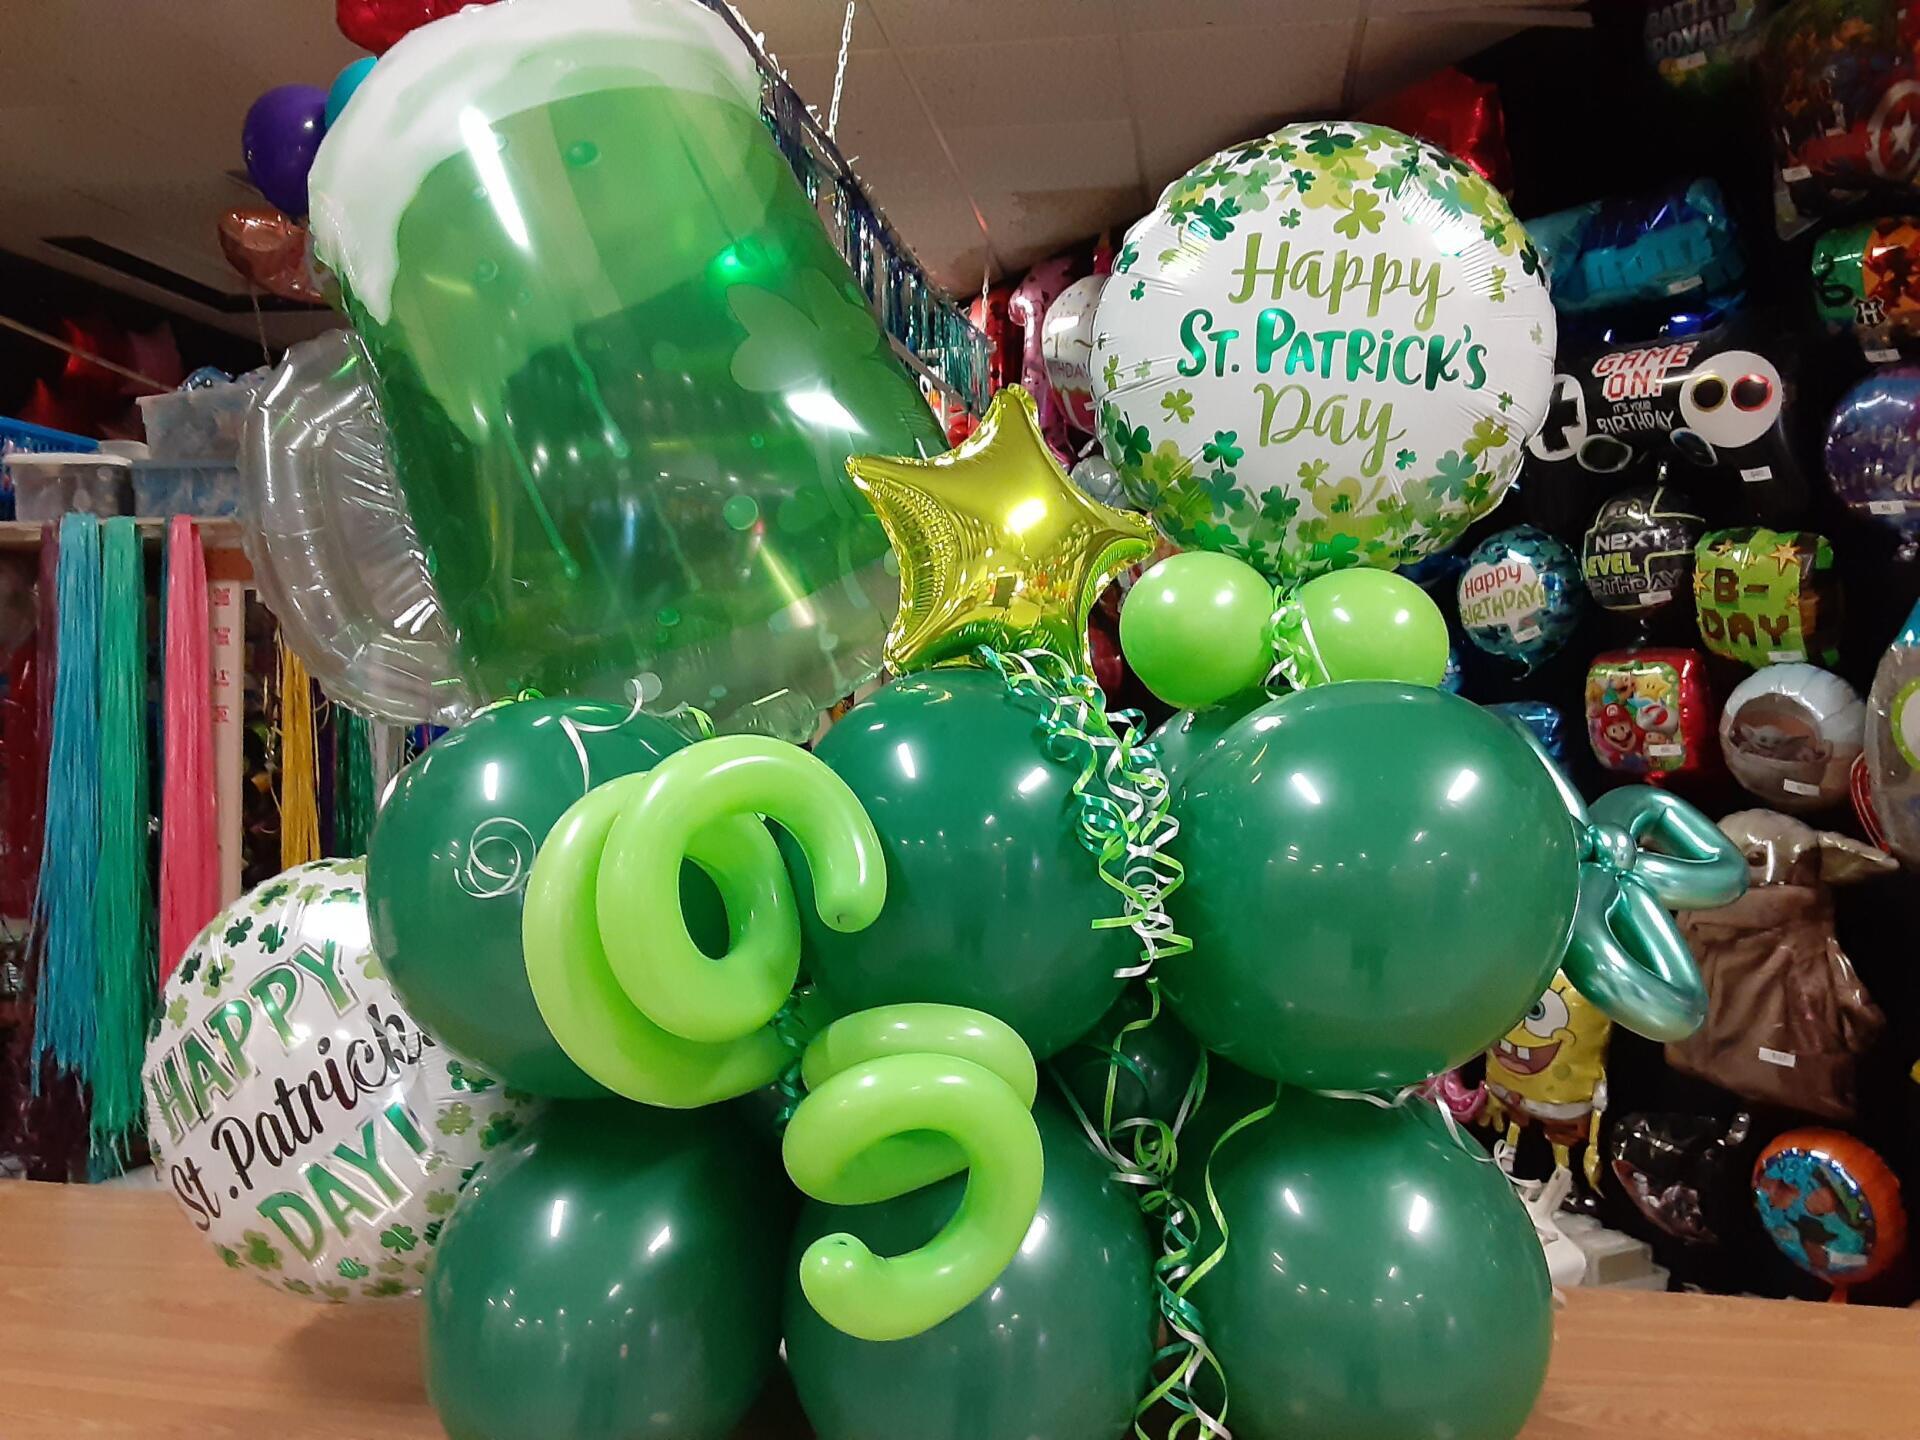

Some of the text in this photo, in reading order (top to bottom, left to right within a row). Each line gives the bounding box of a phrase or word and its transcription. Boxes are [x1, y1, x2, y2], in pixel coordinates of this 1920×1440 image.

[1228, 232, 1455, 331] Happy
[1592, 341, 1699, 377] GAME
[1603, 366, 1667, 401] ON!
[1253, 384, 1407, 478] Day
[1597, 410, 1674, 434] BIRTHDAY
[1595, 529, 1670, 552] NEXT
[1464, 563, 1523, 599] Happy
[1587, 552, 1640, 577] EVEL
[1588, 569, 1684, 596] RTHDAY
[1701, 608, 1790, 646] DAY
[149, 940, 361, 1143] HAPPY
[211, 1003, 435, 1191] Patrick
[256, 1102, 433, 1264] DAY!
